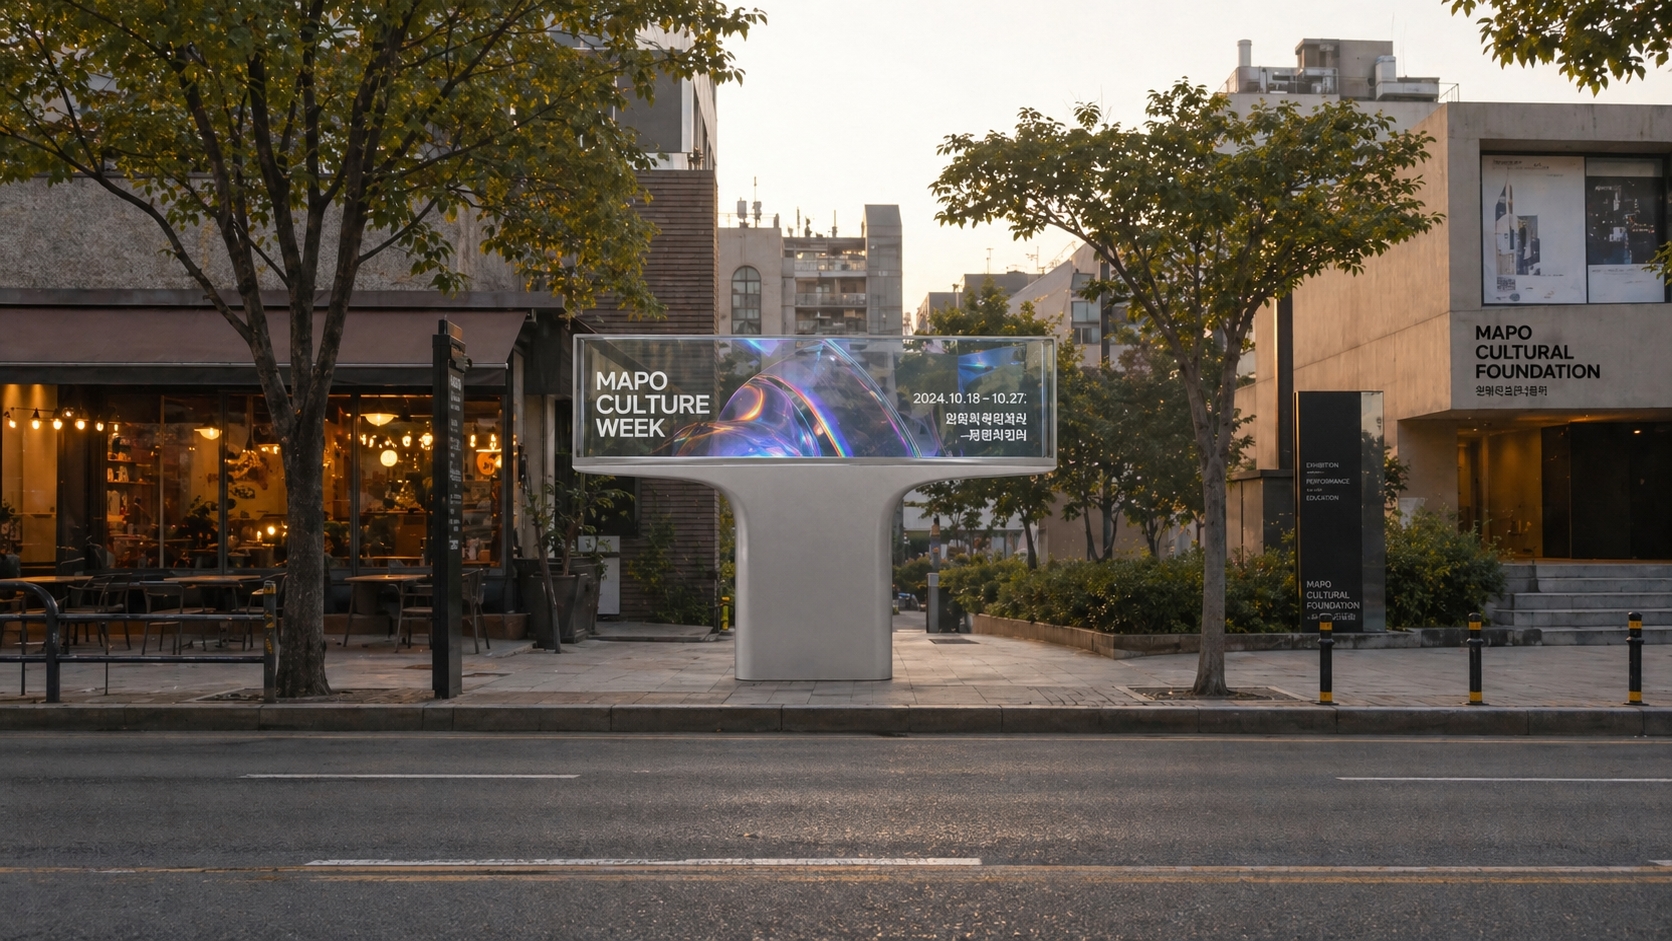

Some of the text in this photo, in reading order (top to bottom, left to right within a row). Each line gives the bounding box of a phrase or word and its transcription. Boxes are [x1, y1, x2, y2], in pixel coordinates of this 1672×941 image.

[1475, 325, 1532, 340] MAPO
[1475, 344, 1574, 360] CULTURAL
[1475, 364, 1601, 379] FOUNDATION
[596, 371, 668, 391] MAPO
[596, 394, 710, 415] CULTURE
[596, 418, 666, 437] WEEK
[1306, 580, 1332, 588] MAPO
[1306, 591, 1350, 599] CULTURAL
[1306, 601, 1360, 610] FOUNDATION
